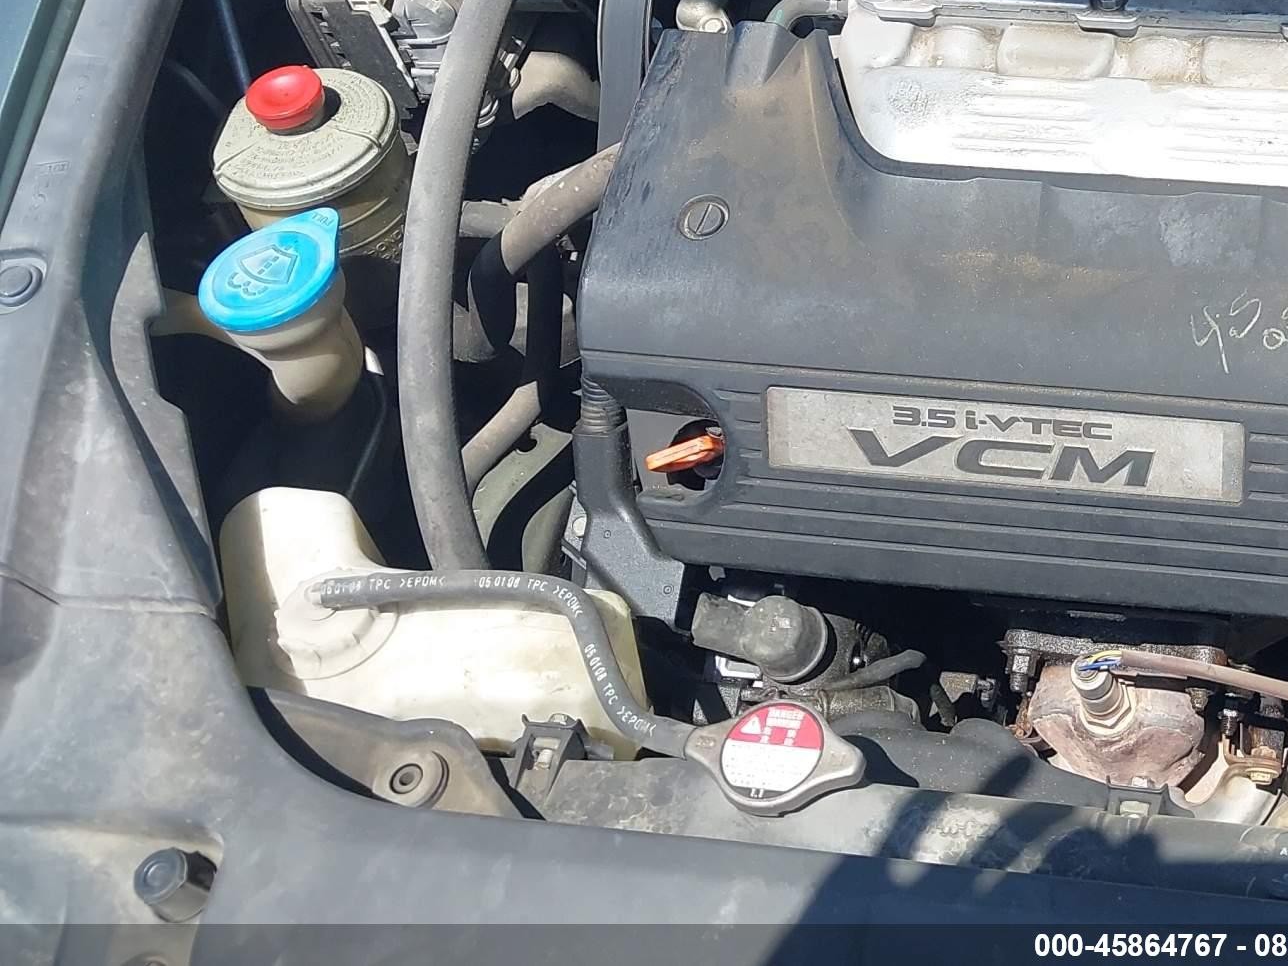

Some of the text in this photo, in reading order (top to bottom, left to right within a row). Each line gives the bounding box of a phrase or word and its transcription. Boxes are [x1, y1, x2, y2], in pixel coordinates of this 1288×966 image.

[892, 404, 957, 430] 3.5
[846, 425, 1157, 489] VCM
[369, 578, 391, 591] TPC
[527, 578, 547, 593] TPC
[603, 682, 618, 706] TPC
